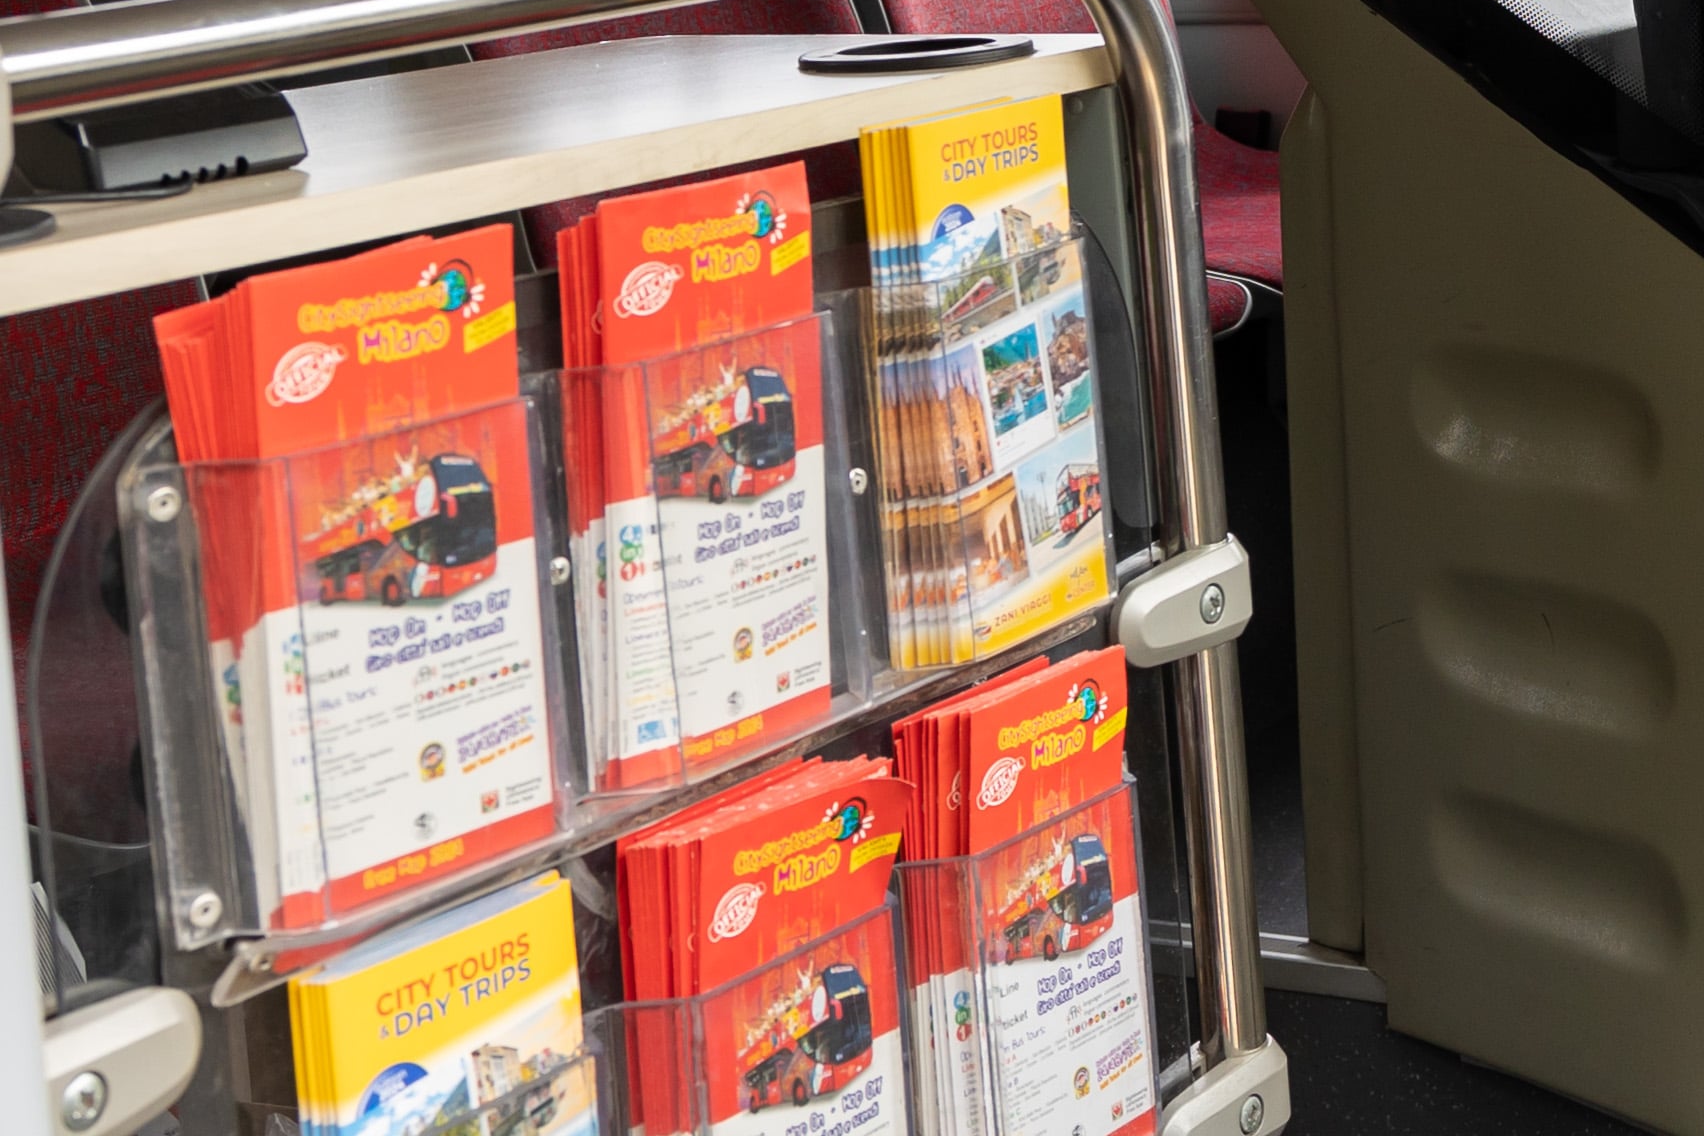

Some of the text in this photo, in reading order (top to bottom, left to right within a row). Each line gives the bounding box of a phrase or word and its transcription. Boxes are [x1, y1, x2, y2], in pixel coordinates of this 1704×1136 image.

[941, 122, 1038, 163] CITY TOURS
[952, 155, 987, 182] DAY
[992, 143, 1039, 171] TRIPS
[375, 932, 531, 1017] CITY TOURS
[394, 992, 450, 1037] DAY
[459, 958, 532, 1007] TRIPS
